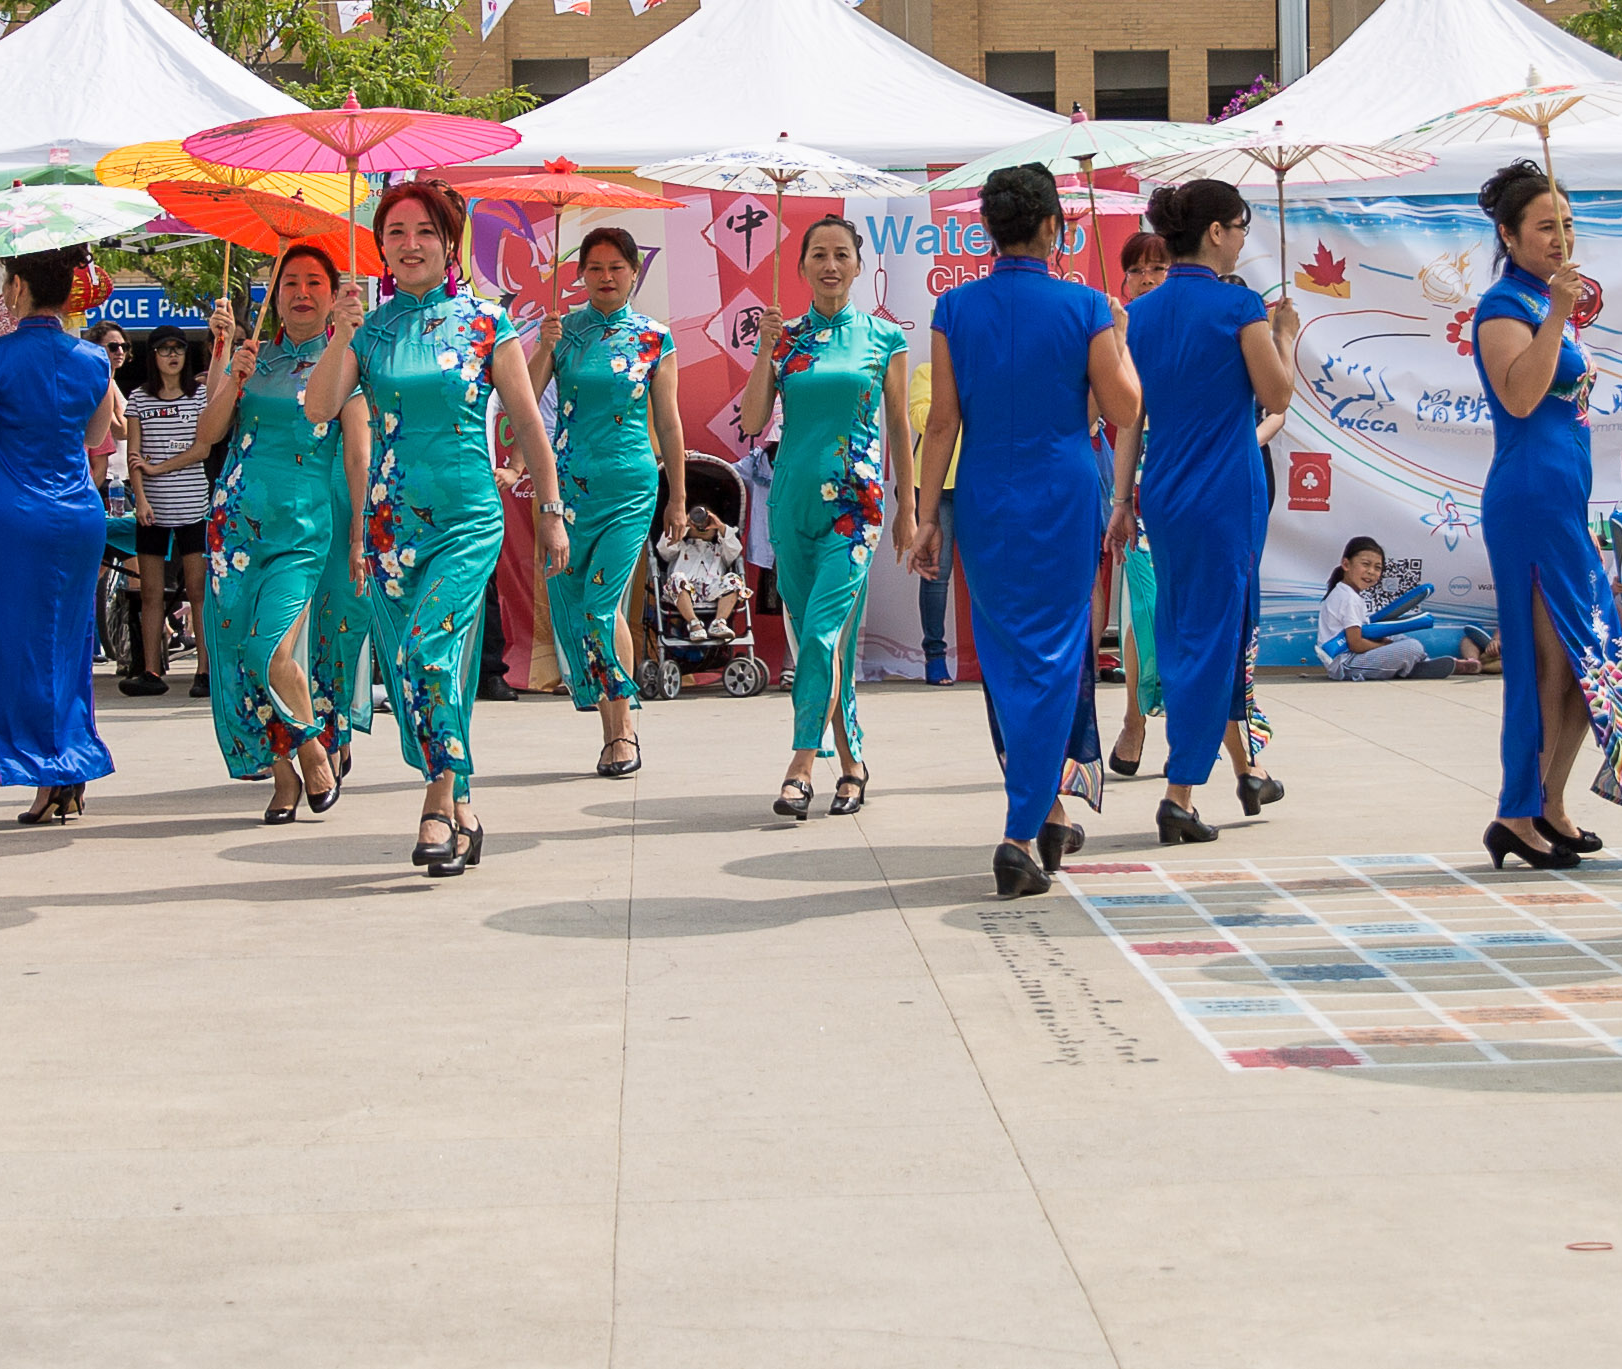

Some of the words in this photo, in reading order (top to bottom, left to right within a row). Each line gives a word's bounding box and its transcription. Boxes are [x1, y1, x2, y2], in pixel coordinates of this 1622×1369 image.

[85, 299, 149, 319] CYCLE
[1337, 415, 1399, 433] WCCA
[1415, 422, 1472, 435] Waterloo
